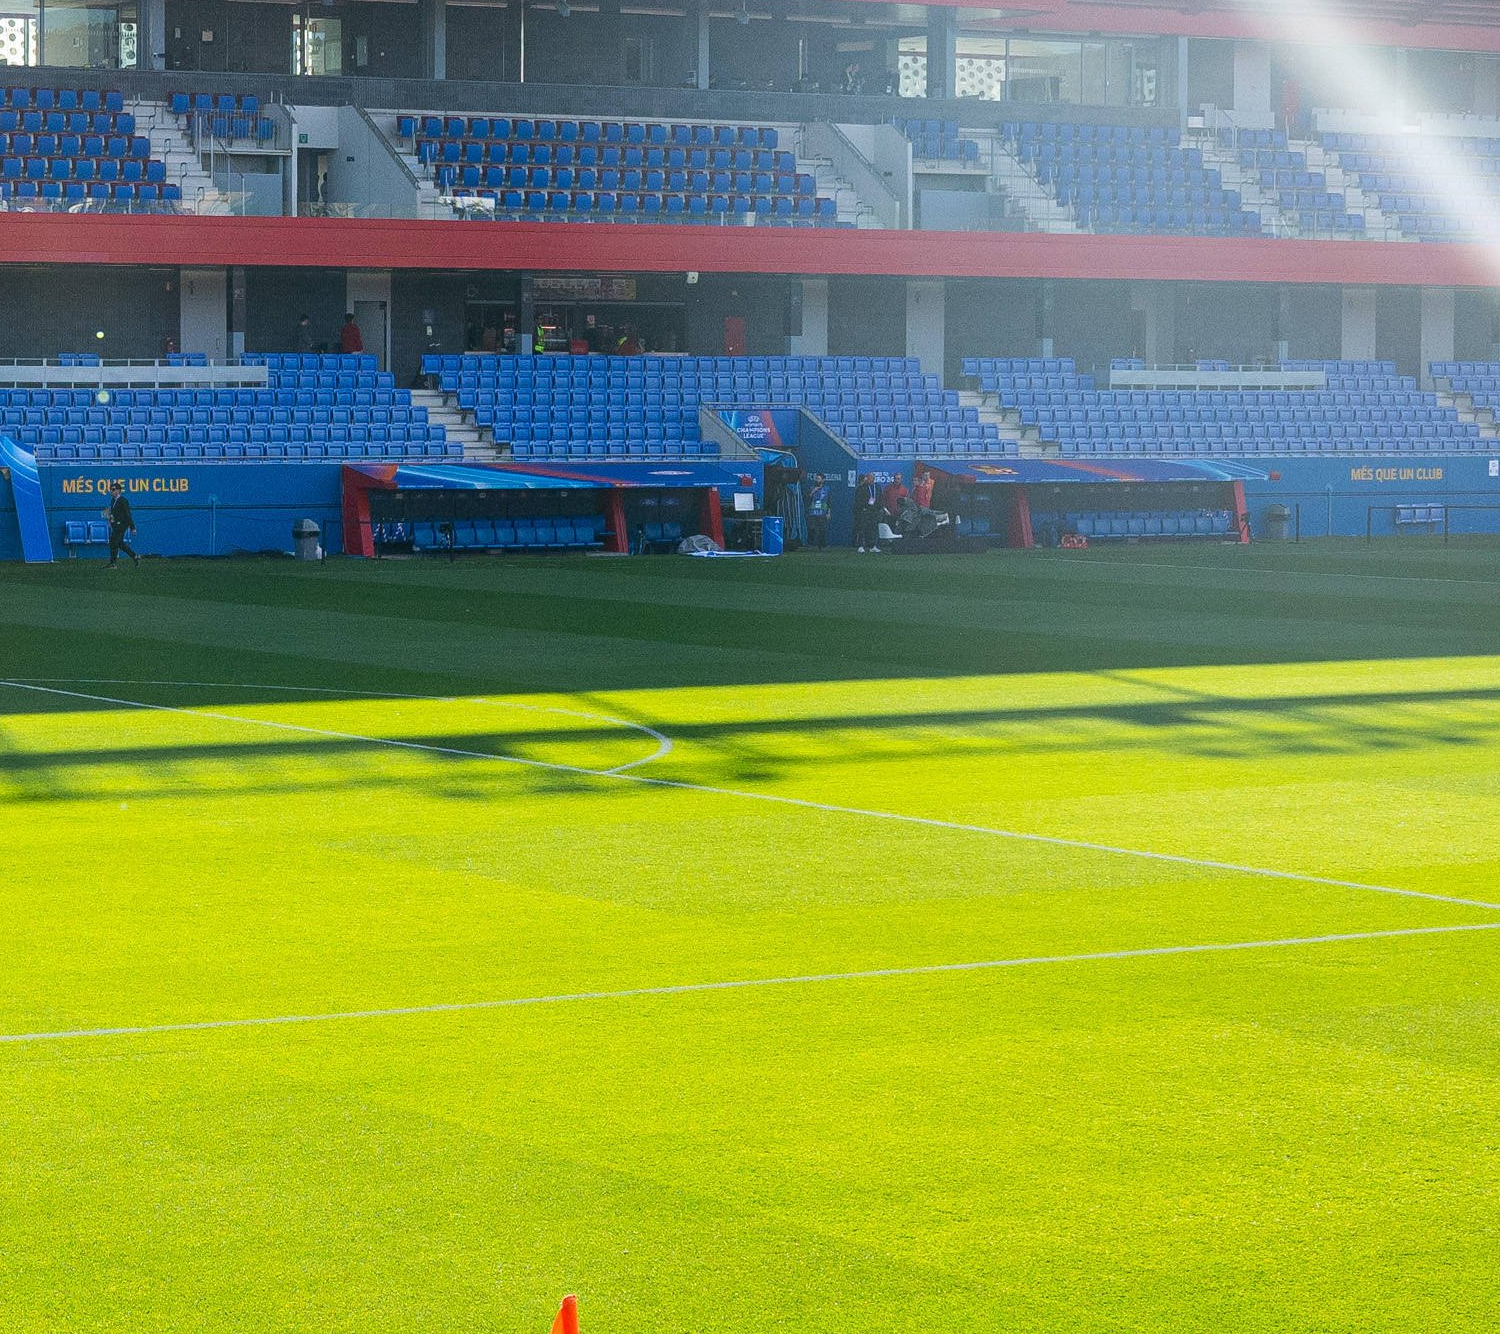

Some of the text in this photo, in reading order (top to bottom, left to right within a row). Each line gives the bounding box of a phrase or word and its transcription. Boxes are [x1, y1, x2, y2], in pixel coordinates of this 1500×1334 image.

[62, 476, 93, 493] MÉS
[129, 478, 149, 492] UN
[152, 478, 189, 492] CLUB
